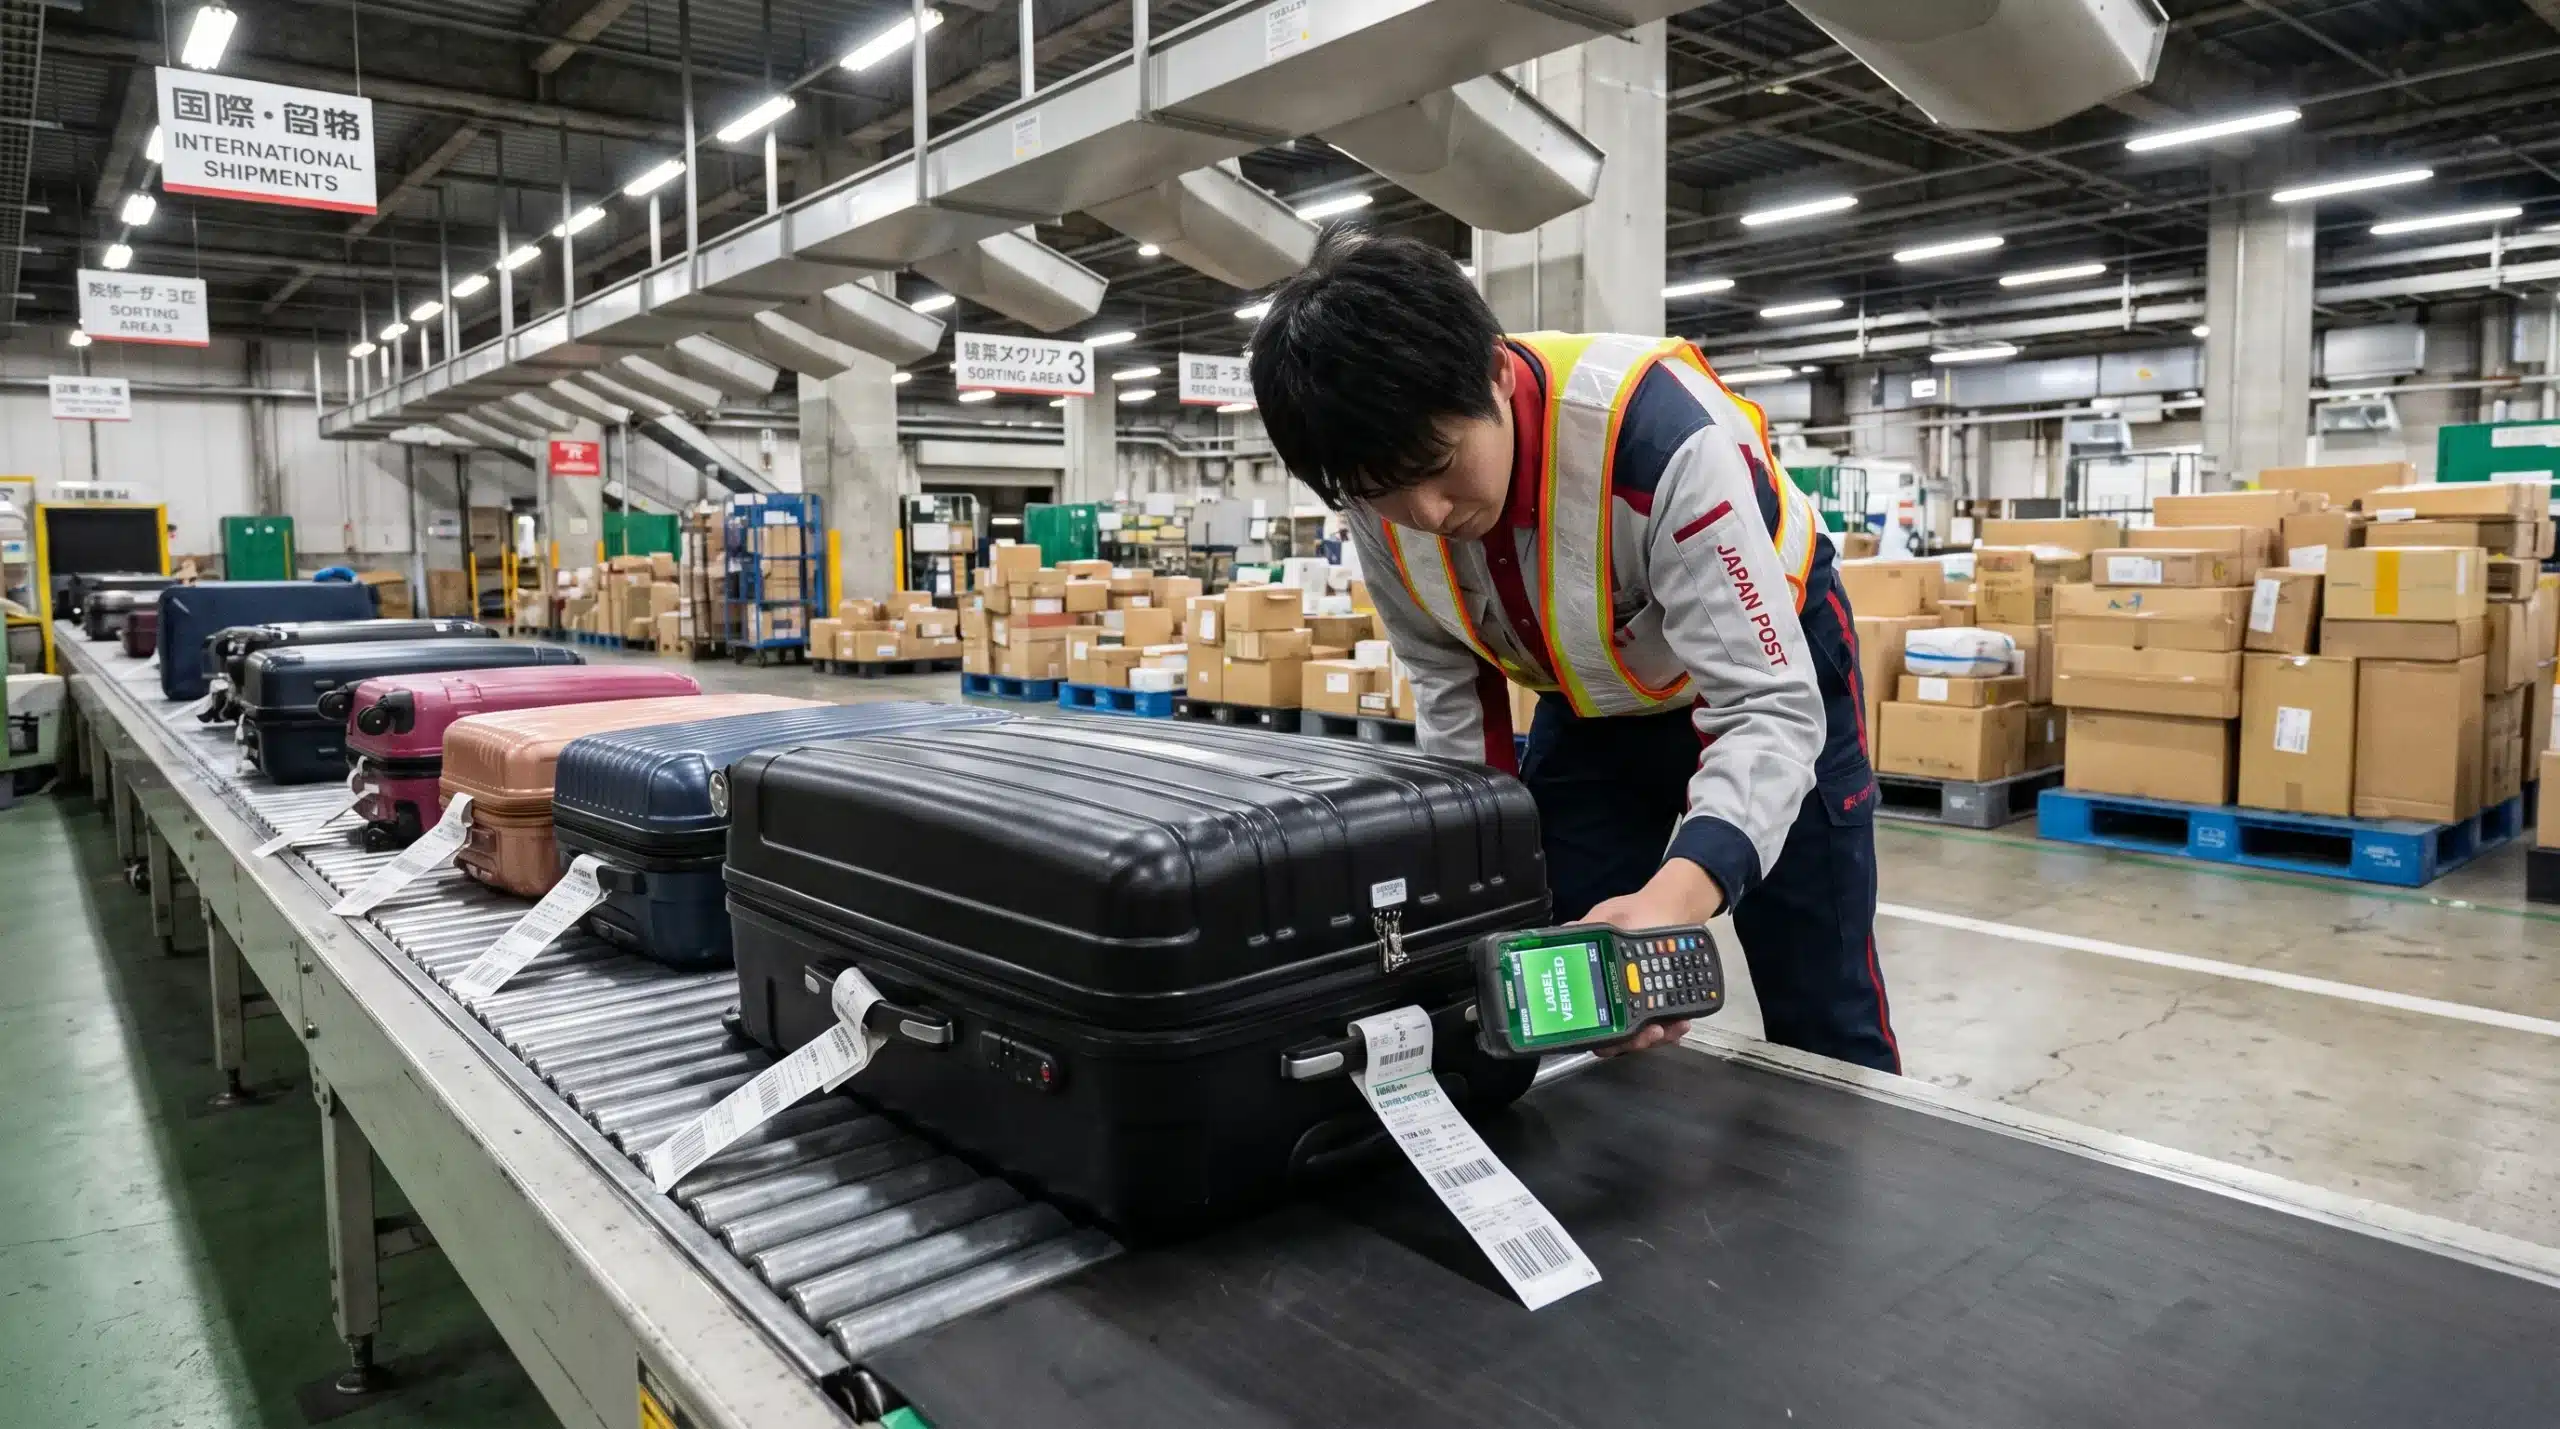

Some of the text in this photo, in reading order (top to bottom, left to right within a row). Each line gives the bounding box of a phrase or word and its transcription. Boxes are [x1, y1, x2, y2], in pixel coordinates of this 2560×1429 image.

[175, 132, 363, 171] INTERNATIONAL
[204, 160, 339, 192] SHIPMENTS
[109, 304, 180, 320] SORTING
[120, 320, 160, 333] AREA
[967, 366, 1064, 384] SORTING AREA
[1068, 350, 1086, 385] 3
[1717, 545, 1788, 666] JAPAN POST
[1541, 969, 1557, 1012] LABEL
[1553, 956, 1574, 1022] VERIFIED
